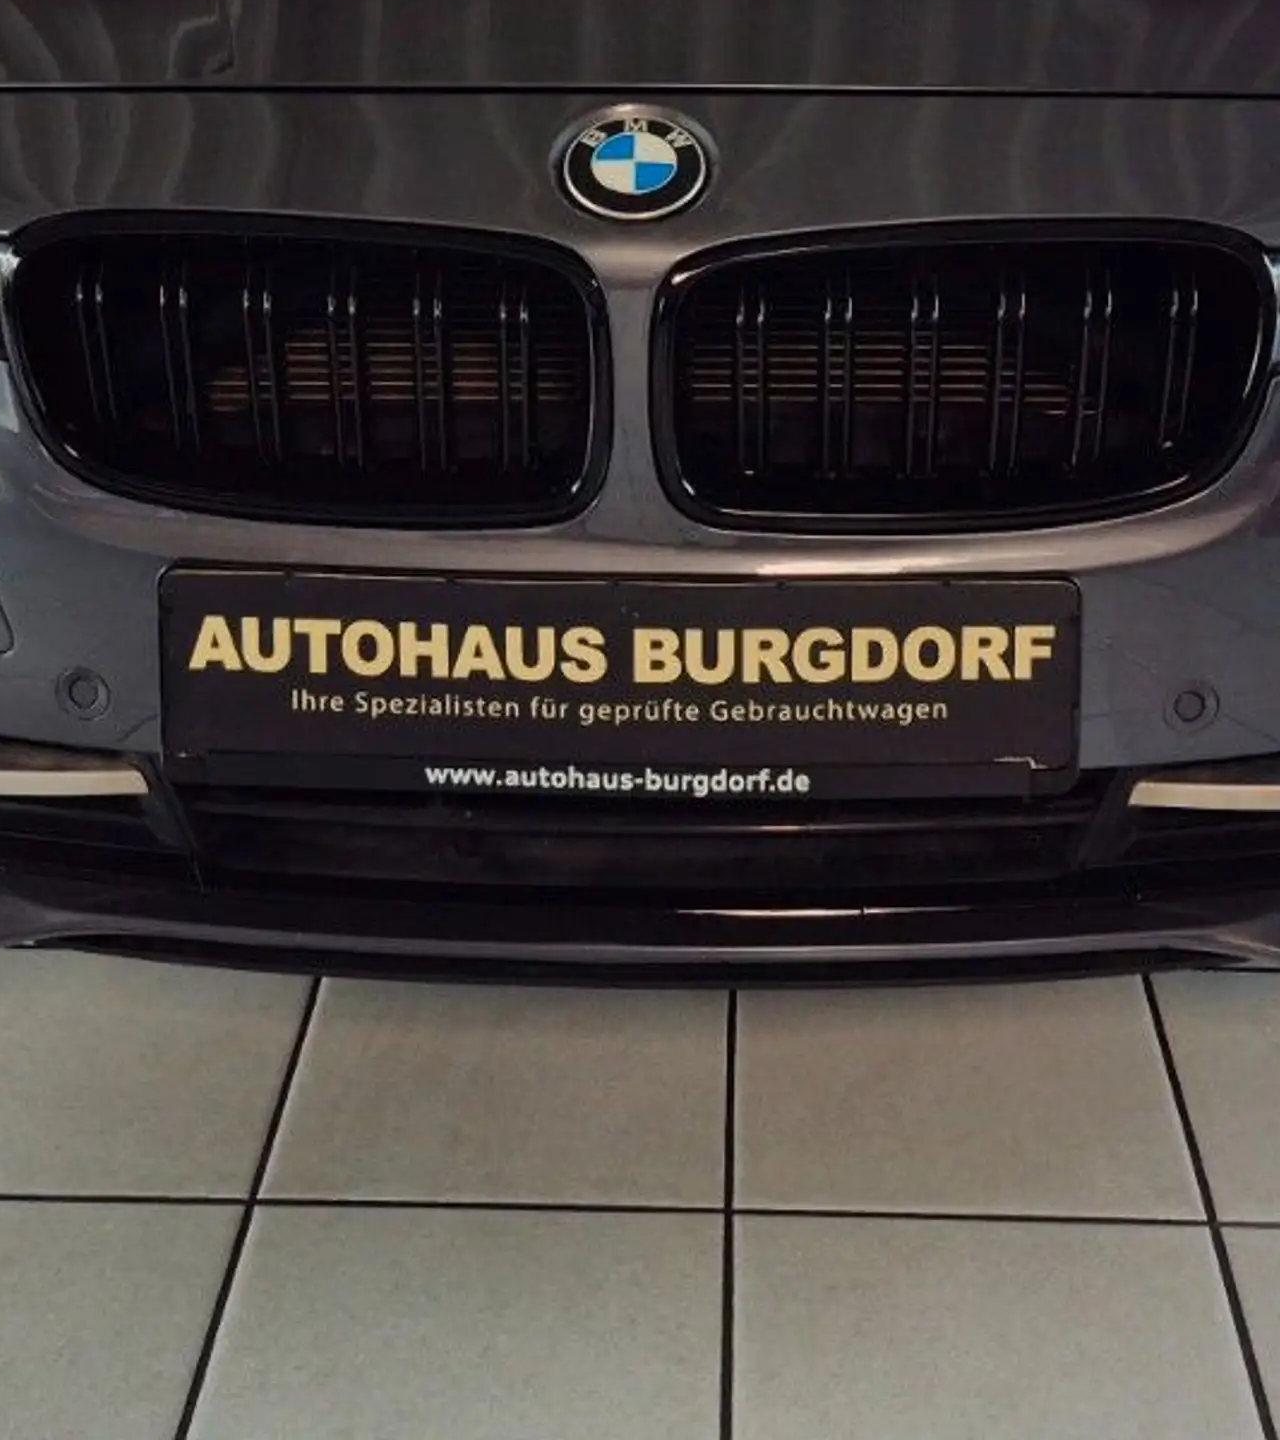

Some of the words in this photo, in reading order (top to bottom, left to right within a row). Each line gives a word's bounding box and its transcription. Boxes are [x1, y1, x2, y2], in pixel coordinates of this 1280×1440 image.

[579, 117, 694, 148] BMW
[188, 614, 608, 684] AUTOHAUS
[632, 625, 1057, 685] BURGDORF
[291, 688, 345, 714] Ihre
[354, 691, 520, 719] Spezialisten
[529, 696, 569, 720] für
[578, 698, 699, 726] geprüfte
[709, 698, 949, 727] Gebrauchtwagen
[424, 765, 812, 797] www.autohaus-burgdorf.de
